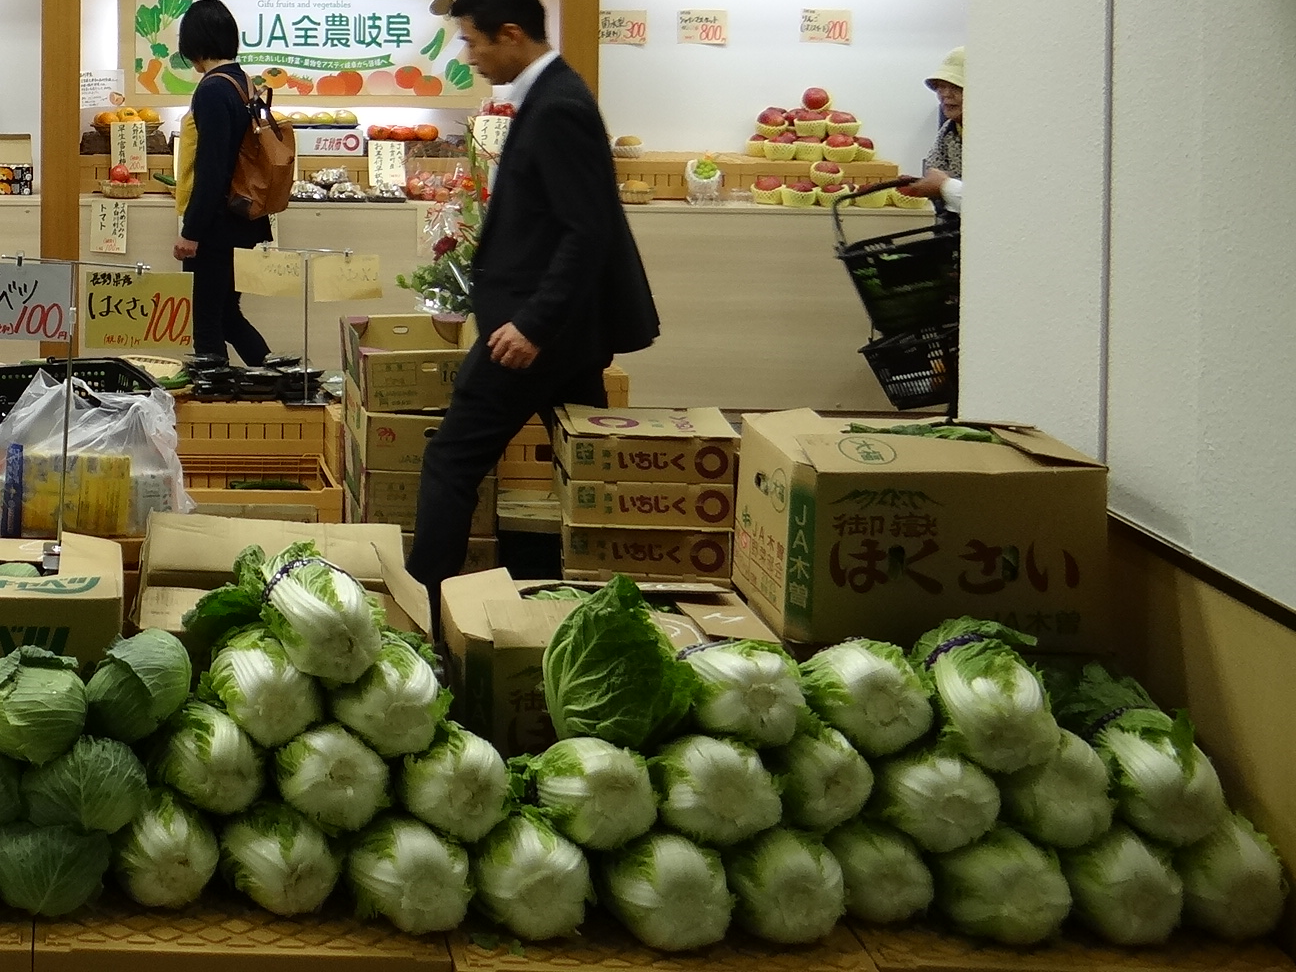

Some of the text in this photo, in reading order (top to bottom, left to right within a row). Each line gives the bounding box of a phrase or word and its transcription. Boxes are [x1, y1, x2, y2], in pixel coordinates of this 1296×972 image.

[257, 0, 351, 11] Gifu fruits and vegetables
[241, 12, 413, 48] JA全農岐阜
[98, 204, 107, 231] トマト
[117, 202, 126, 239] JAめぐみの
[89, 272, 134, 286] 長野県産
[88, 292, 159, 320] はくさい
[618, 450, 686, 471] いちじく
[618, 494, 687, 516] いちじく
[611, 541, 682, 565] いちじく
[829, 538, 1080, 596] はくさい
